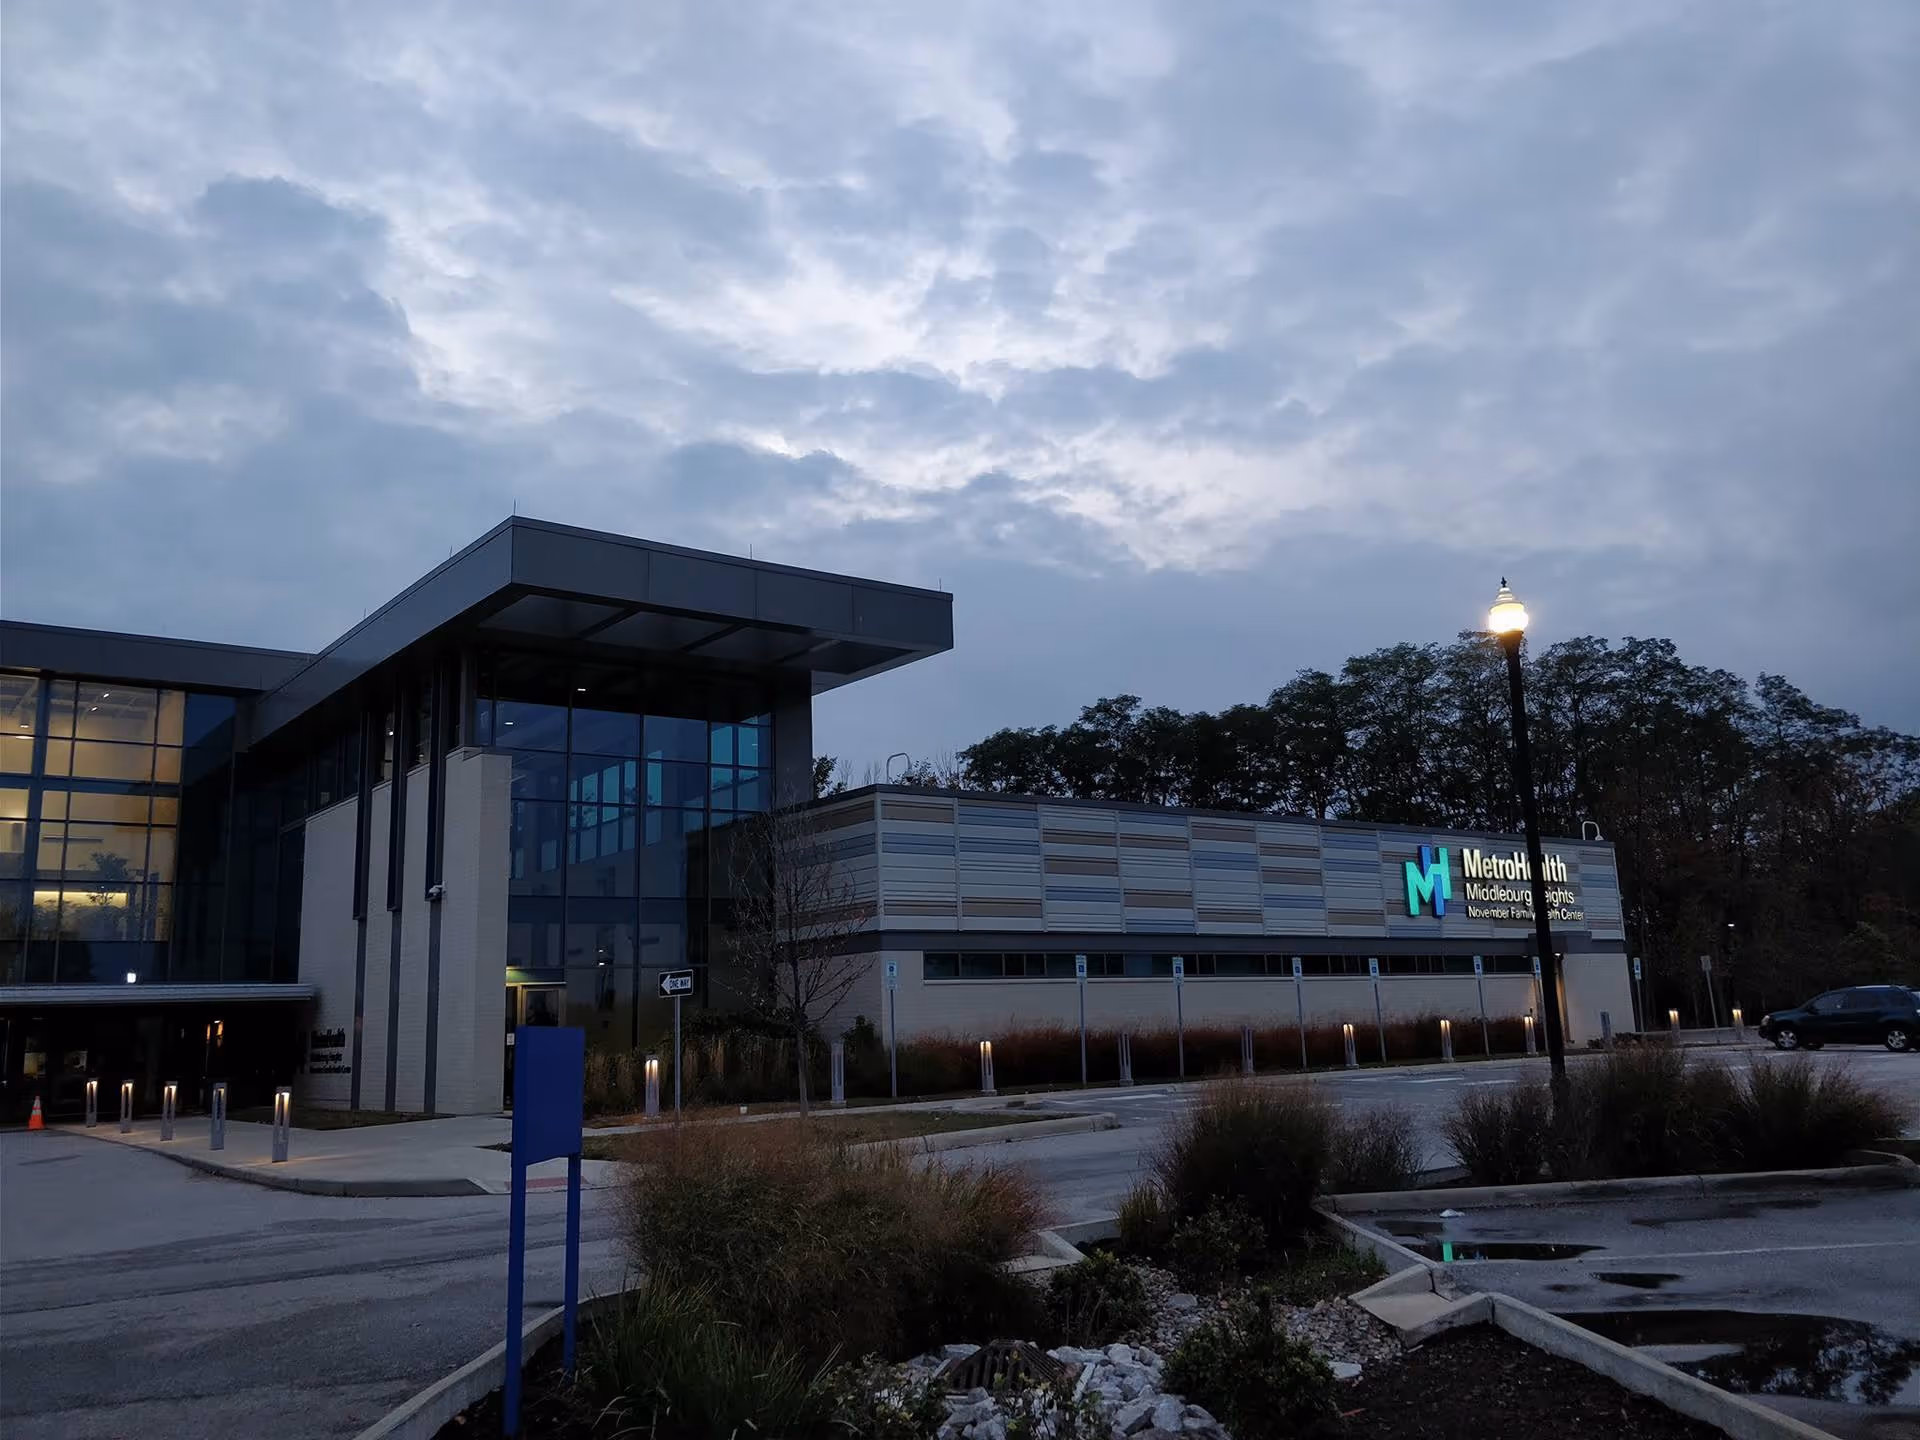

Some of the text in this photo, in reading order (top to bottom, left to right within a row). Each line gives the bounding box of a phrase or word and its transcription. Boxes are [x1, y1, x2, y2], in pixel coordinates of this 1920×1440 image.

[1466, 883, 1533, 907] Middleburg
[1468, 905, 1510, 919] November
[1511, 907, 1536, 921] Family
[1561, 908, 1584, 921] Center
[670, 978, 690, 989] ONE WAY
